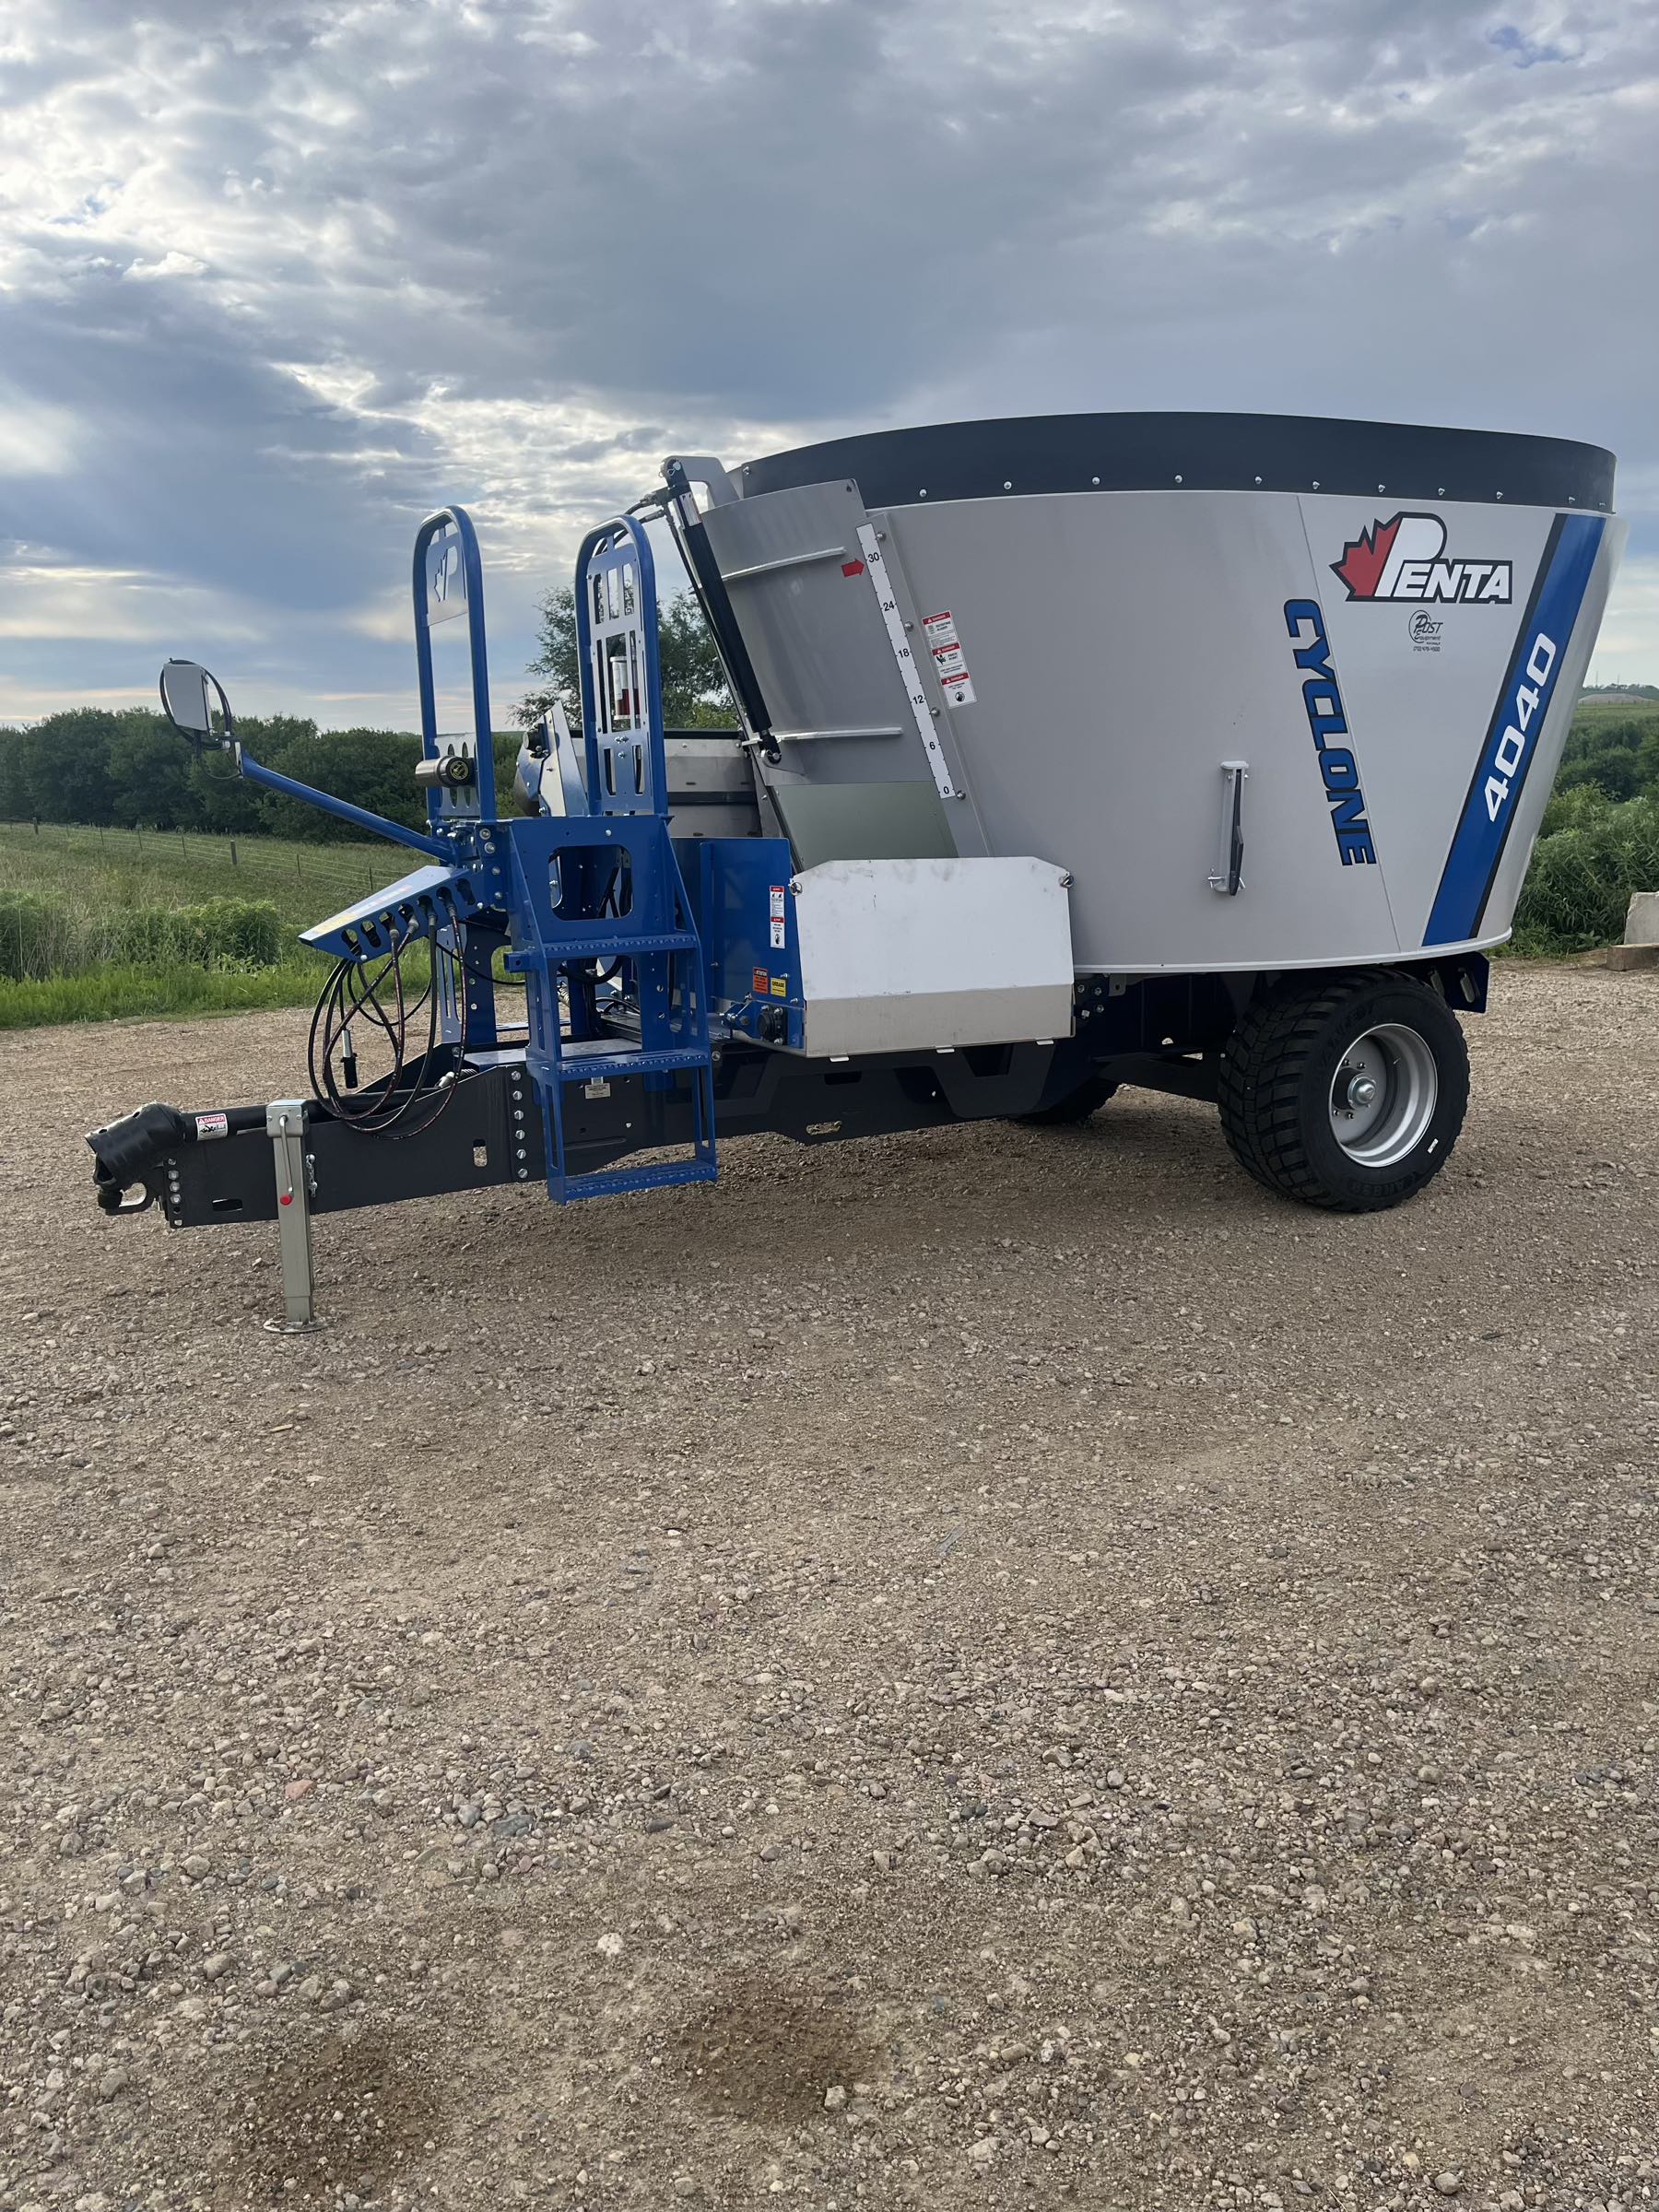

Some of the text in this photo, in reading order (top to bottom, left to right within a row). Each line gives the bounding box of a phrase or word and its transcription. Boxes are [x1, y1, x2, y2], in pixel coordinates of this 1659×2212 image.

[866, 552, 880, 563] 30
[1372, 513, 1512, 602] PENTA
[883, 600, 895, 612] 24
[1413, 614, 1444, 633] POST
[899, 648, 910, 659] 18
[913, 694, 924, 705] 12
[1284, 598, 1377, 866] CYCLONE
[1484, 632, 1557, 822] 4040
[929, 741, 936, 750] 6
[943, 785, 950, 794] 0
[204, 1115, 225, 1124] DANGER
